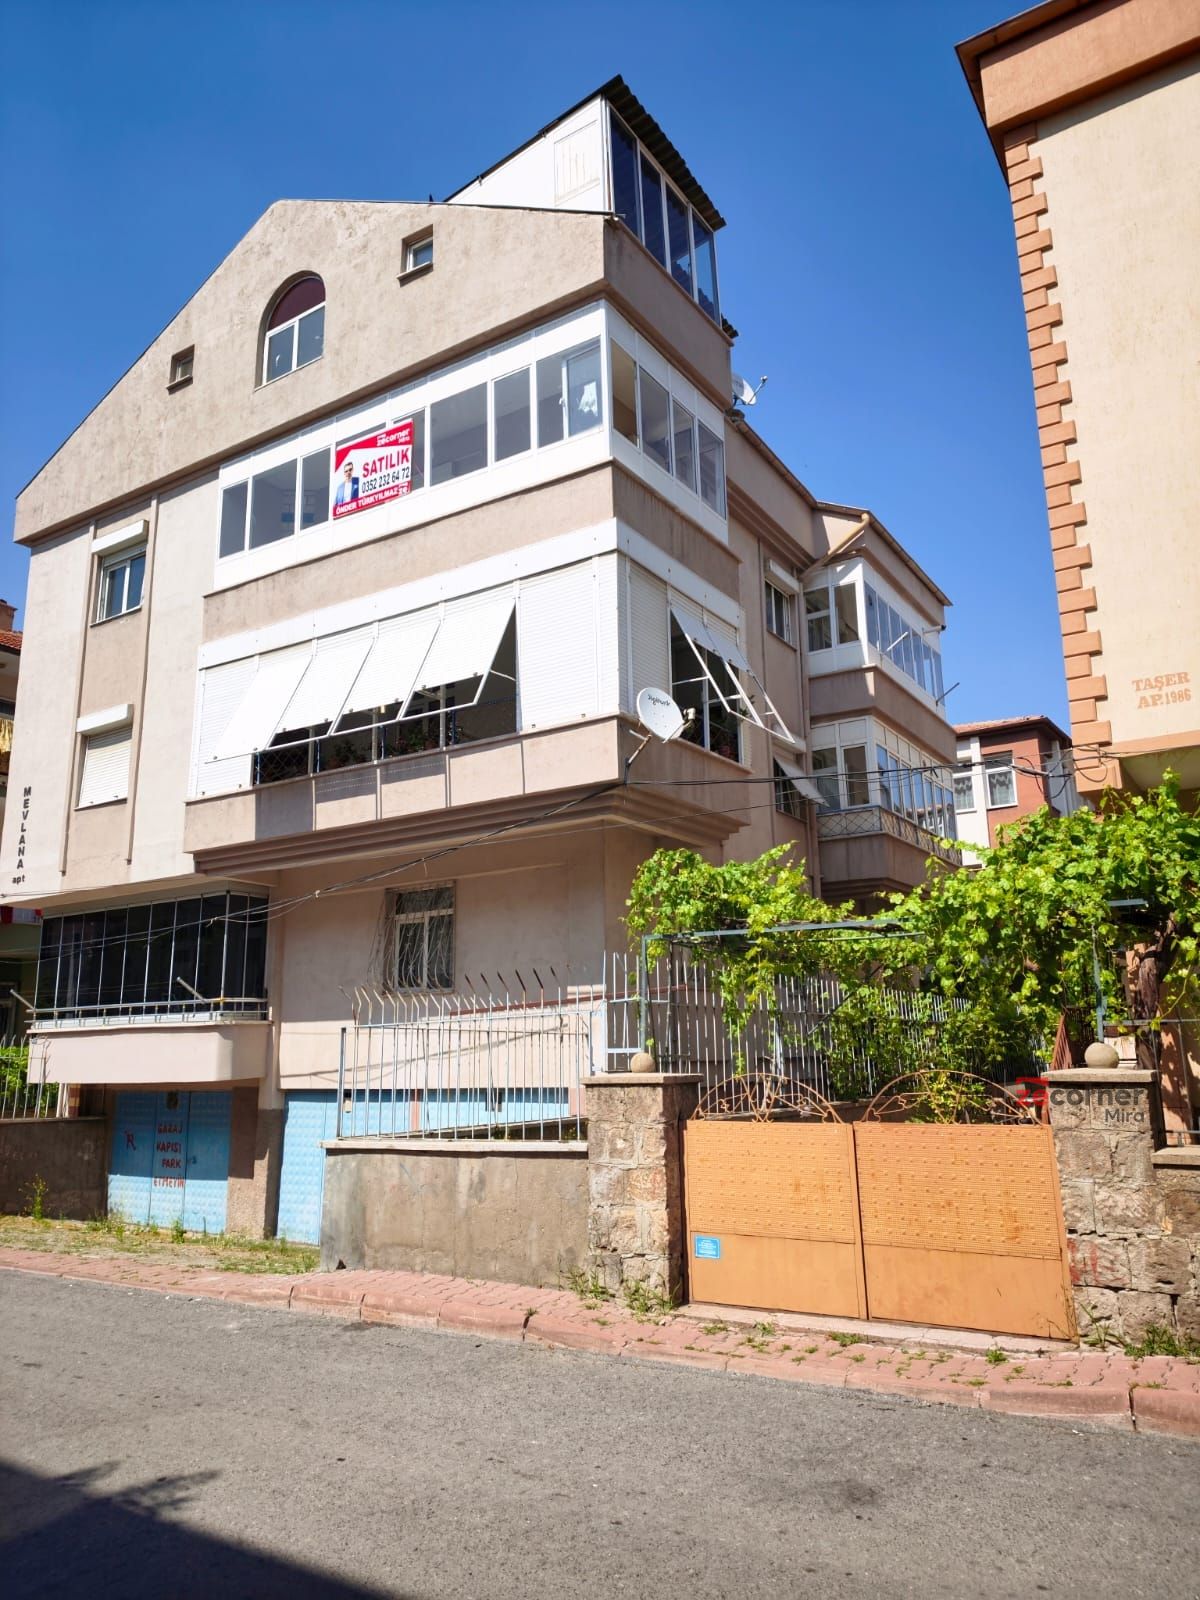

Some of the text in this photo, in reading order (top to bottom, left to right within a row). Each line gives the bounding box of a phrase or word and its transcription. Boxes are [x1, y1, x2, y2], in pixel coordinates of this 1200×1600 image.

[362, 447, 409, 478] SATILIK
[361, 466, 410, 494] 0352 232 64 72
[335, 502, 357, 515] ÖNDER
[358, 488, 398, 507] TÜRKYILMAZ
[1131, 671, 1190, 692] TAŞER
[16, 786, 32, 870] MEVLANA
[12, 874, 26, 885] apt
